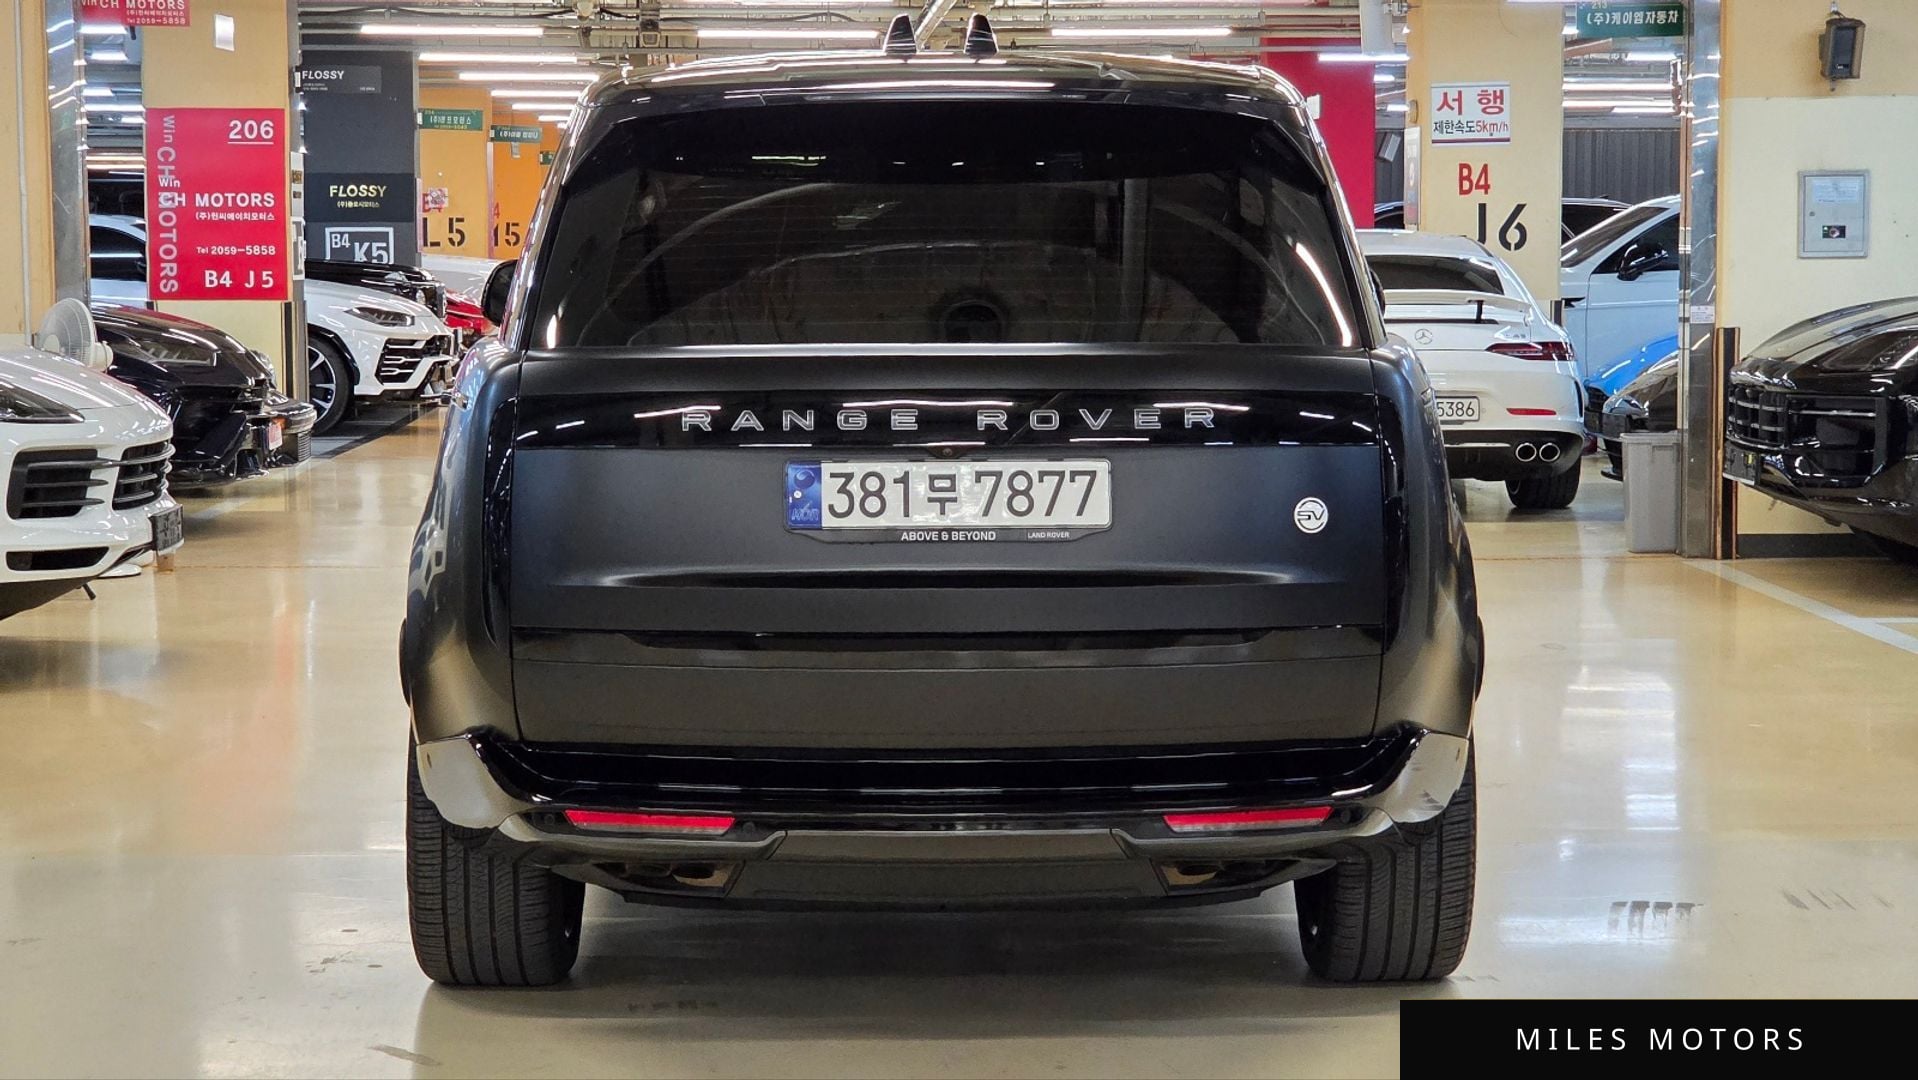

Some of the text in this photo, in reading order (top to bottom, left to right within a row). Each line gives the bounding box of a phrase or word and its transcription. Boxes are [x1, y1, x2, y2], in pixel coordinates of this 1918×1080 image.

[126, 0, 185, 9] MOTORS
[301, 70, 345, 80] FLOSSY
[228, 119, 274, 139] 206
[1458, 163, 1491, 196] B4
[329, 184, 387, 198] FLOSSY
[195, 192, 275, 208] MOTORS
[196, 245, 276, 256] Tel 2059-5858
[331, 233, 389, 265] B4 K5
[204, 269, 233, 288] B4
[1436, 401, 1475, 418] 5386
[681, 407, 1216, 432] RANGE ROVER
[901, 531, 997, 541] ABOVE & BEYOND
[1046, 531, 1071, 539] ROVER
